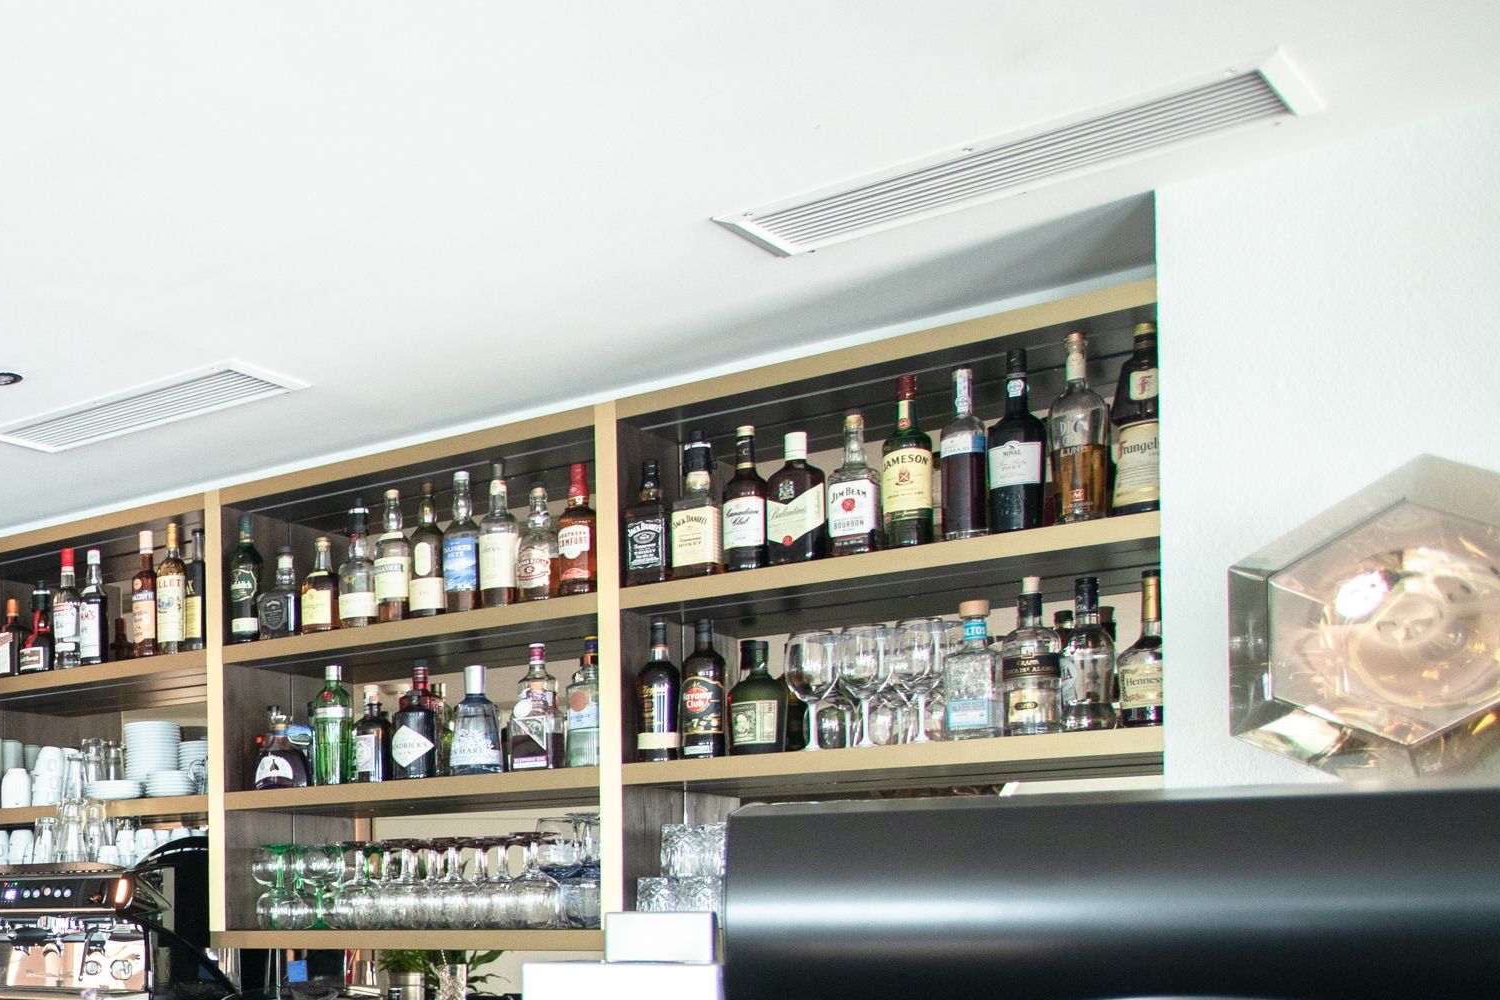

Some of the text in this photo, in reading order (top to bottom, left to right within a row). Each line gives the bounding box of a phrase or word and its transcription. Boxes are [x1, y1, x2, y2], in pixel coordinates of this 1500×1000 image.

[883, 454, 929, 472] JAMESON
[831, 487, 867, 504] JIM BEAM
[673, 519, 685, 530] JACK
[833, 519, 864, 530] BOURBON
[627, 525, 641, 538] JACK
[559, 538, 587, 548] COMFORT
[686, 700, 705, 709] Club
